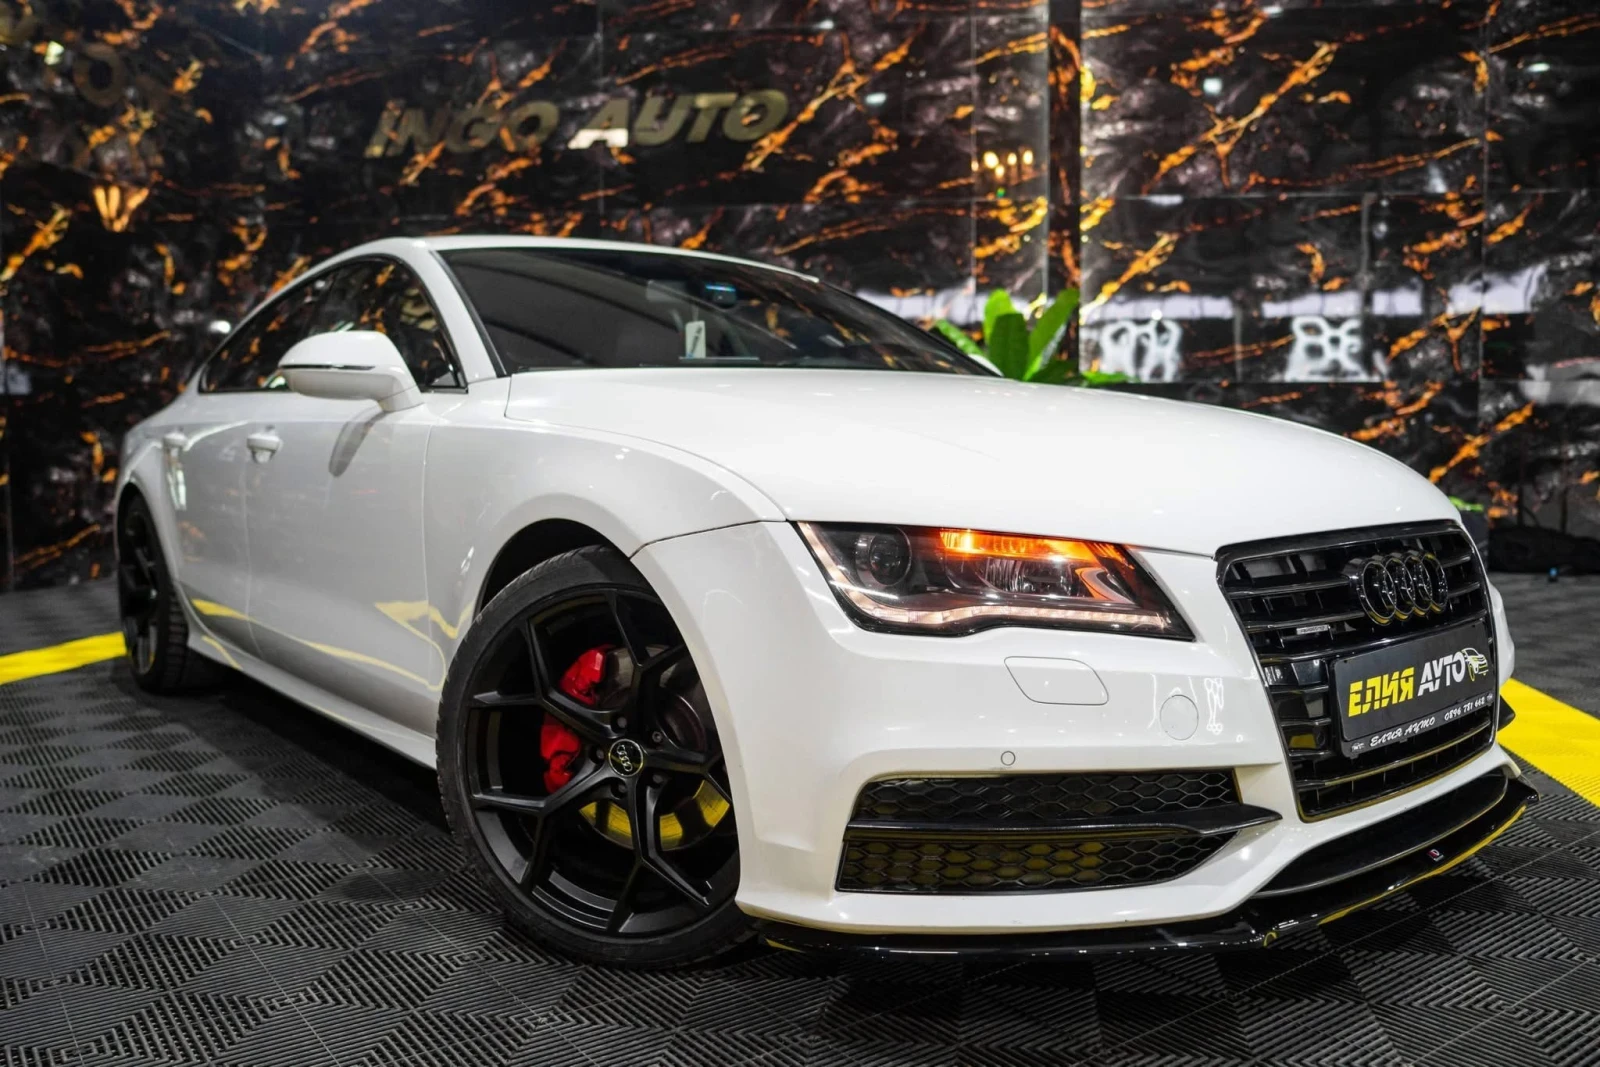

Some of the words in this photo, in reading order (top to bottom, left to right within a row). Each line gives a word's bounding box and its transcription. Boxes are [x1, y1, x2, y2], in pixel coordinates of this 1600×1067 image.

[364, 99, 560, 158] INGO
[567, 90, 789, 149] AUTO
[1348, 667, 1415, 717] ЕЛИЯ
